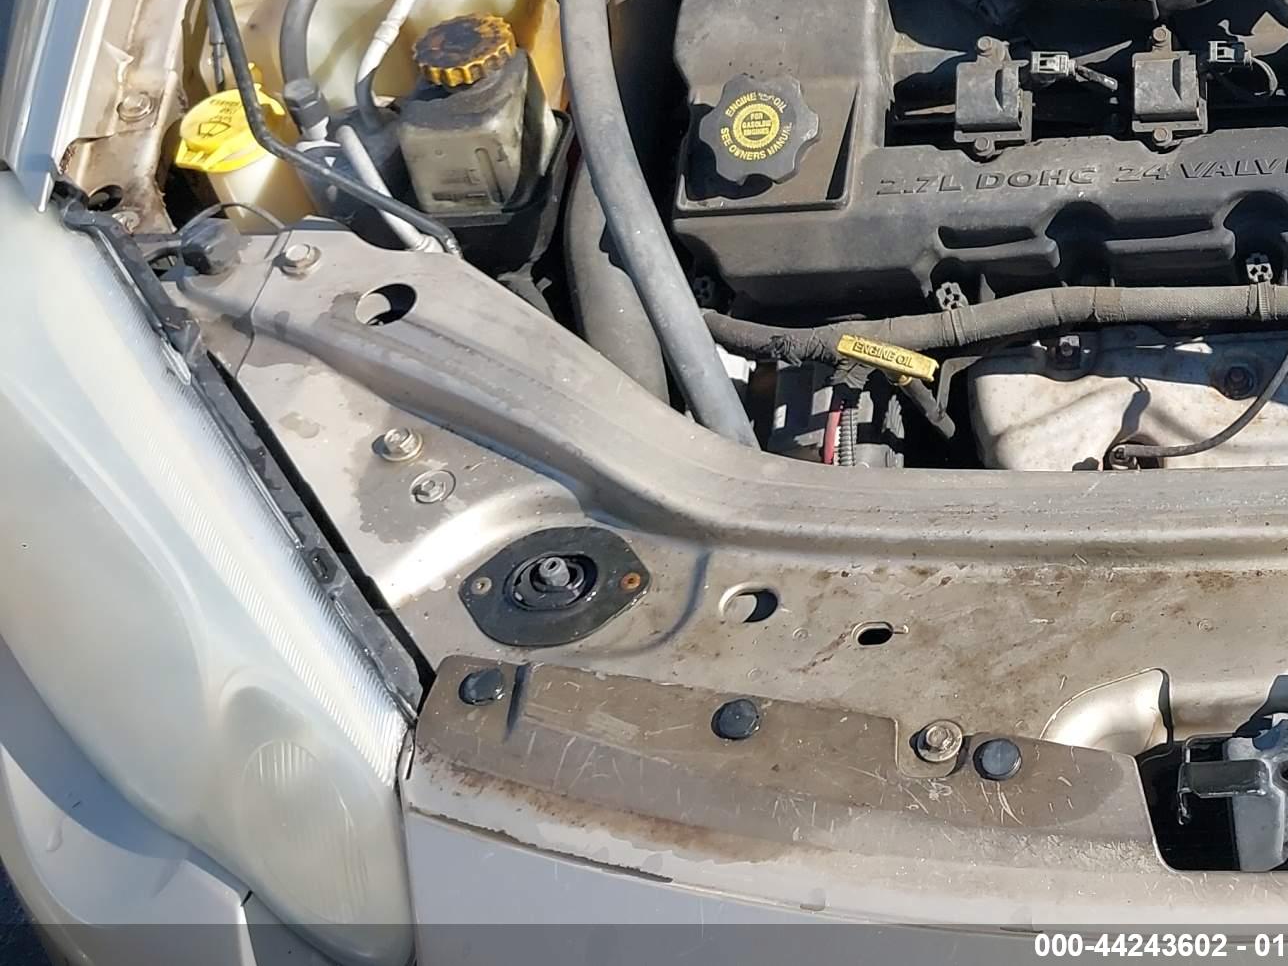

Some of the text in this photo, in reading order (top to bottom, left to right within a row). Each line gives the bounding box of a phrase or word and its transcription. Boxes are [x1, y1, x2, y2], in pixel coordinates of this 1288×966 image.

[725, 92, 788, 117] ENGINE OIL
[720, 122, 793, 161] SEE OWNERS MANUAL
[876, 175, 962, 195] 2.7L
[975, 167, 1096, 190] DOHC
[1114, 165, 1170, 182] 24
[852, 341, 914, 368] ENGINE OIL
